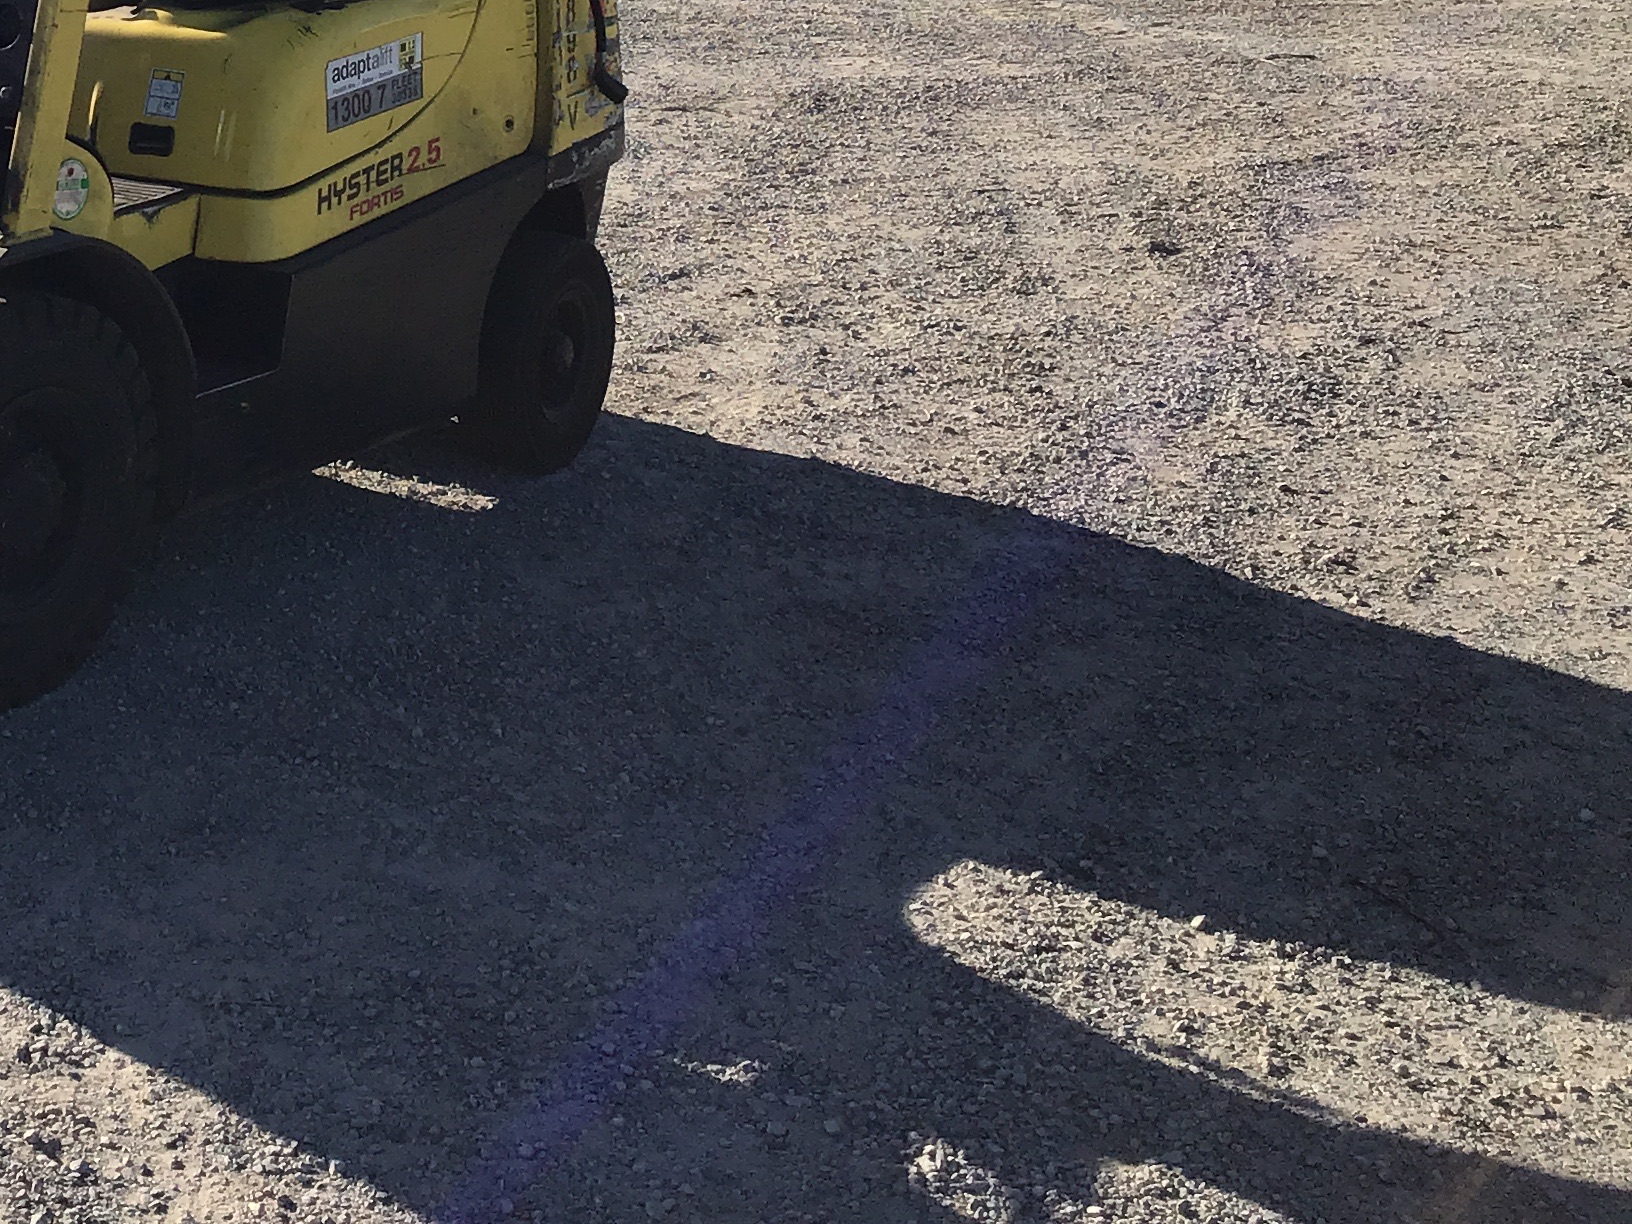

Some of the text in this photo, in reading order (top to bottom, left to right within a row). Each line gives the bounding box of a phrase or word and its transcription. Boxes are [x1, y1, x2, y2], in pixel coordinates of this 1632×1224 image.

[331, 45, 393, 83] adaptalift
[331, 84, 386, 125] 1300 7
[317, 137, 441, 216] HYSTER 2.5
[349, 184, 404, 221] FORTIS
